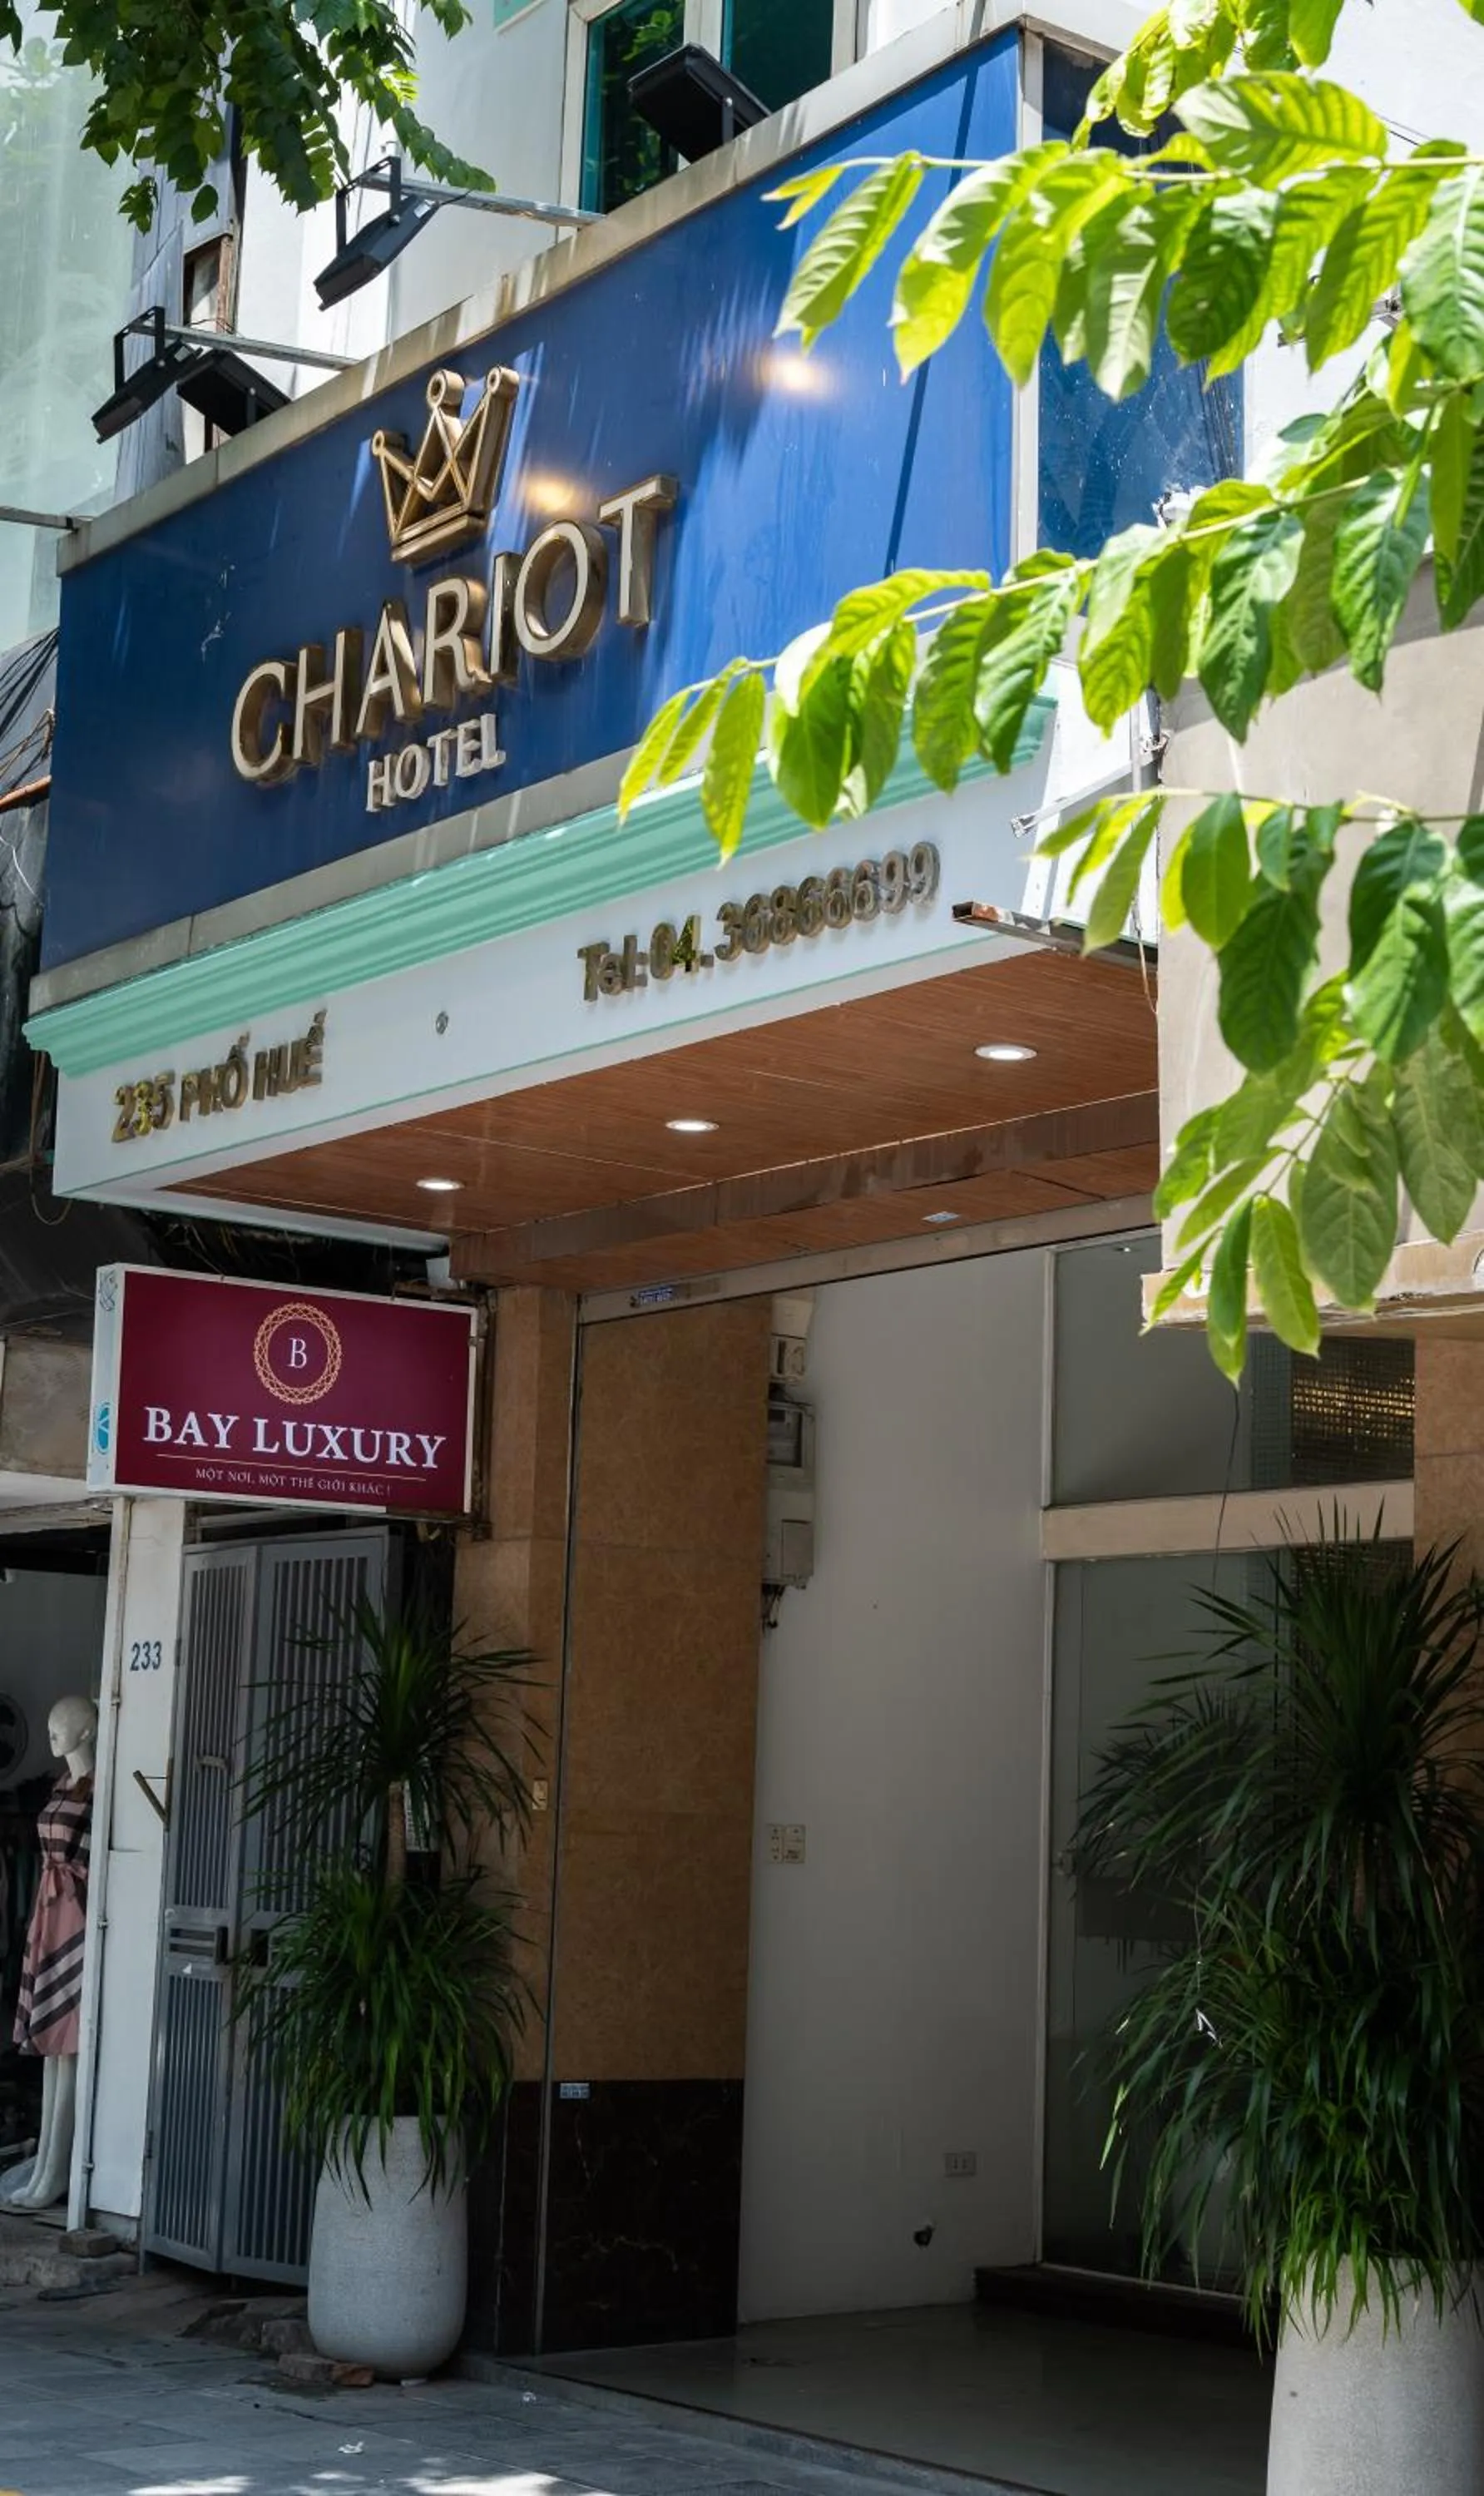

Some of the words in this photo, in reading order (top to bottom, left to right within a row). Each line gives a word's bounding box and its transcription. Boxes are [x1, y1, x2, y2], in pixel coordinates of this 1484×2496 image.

[231, 473, 679, 785] CHARIOT
[366, 713, 506, 813] HOTEL
[111, 1069, 176, 1143] 235
[180, 1031, 251, 1122] PHỐ
[252, 1009, 328, 1101] HUẾ
[289, 1337, 308, 1369] B
[142, 1405, 241, 1449] BAY
[252, 1418, 447, 1469] LUXURY
[195, 1467, 224, 1481] MỘT
[259, 1473, 286, 1488] MỘT
[130, 1641, 162, 1671] 233
